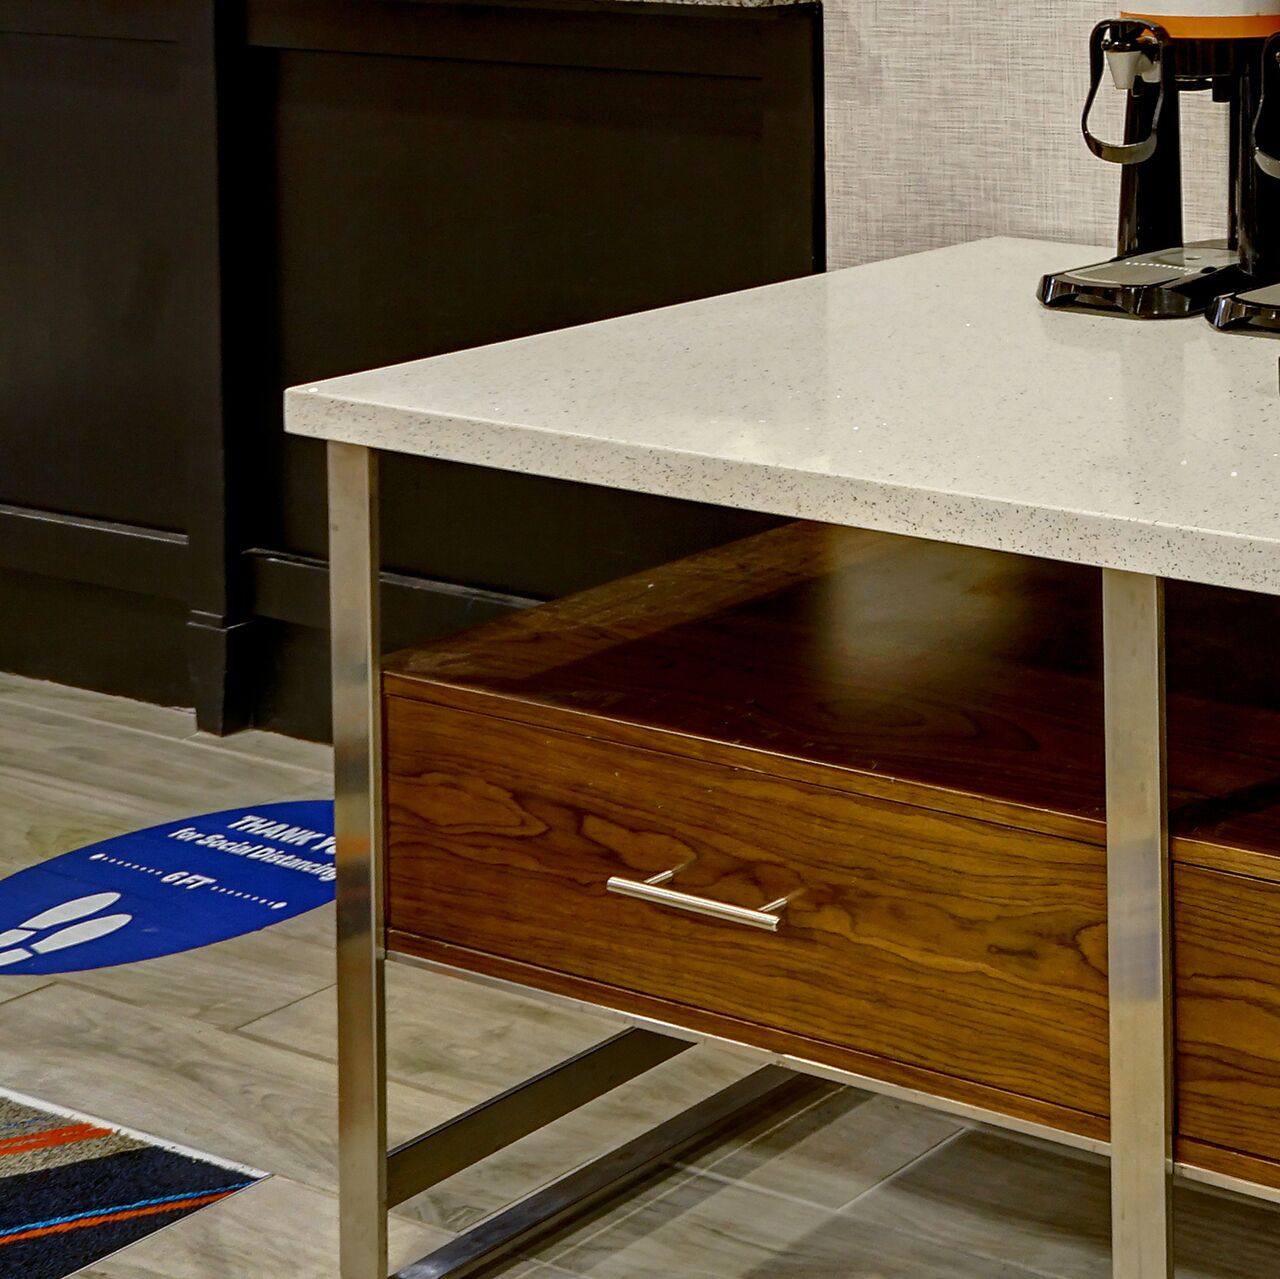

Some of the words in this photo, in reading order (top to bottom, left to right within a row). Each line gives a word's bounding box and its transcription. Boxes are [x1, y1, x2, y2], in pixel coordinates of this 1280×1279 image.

[227, 814, 326, 846] THANK
[168, 827, 206, 842] for
[195, 834, 260, 856] Social
[246, 846, 336, 882] Distancing
